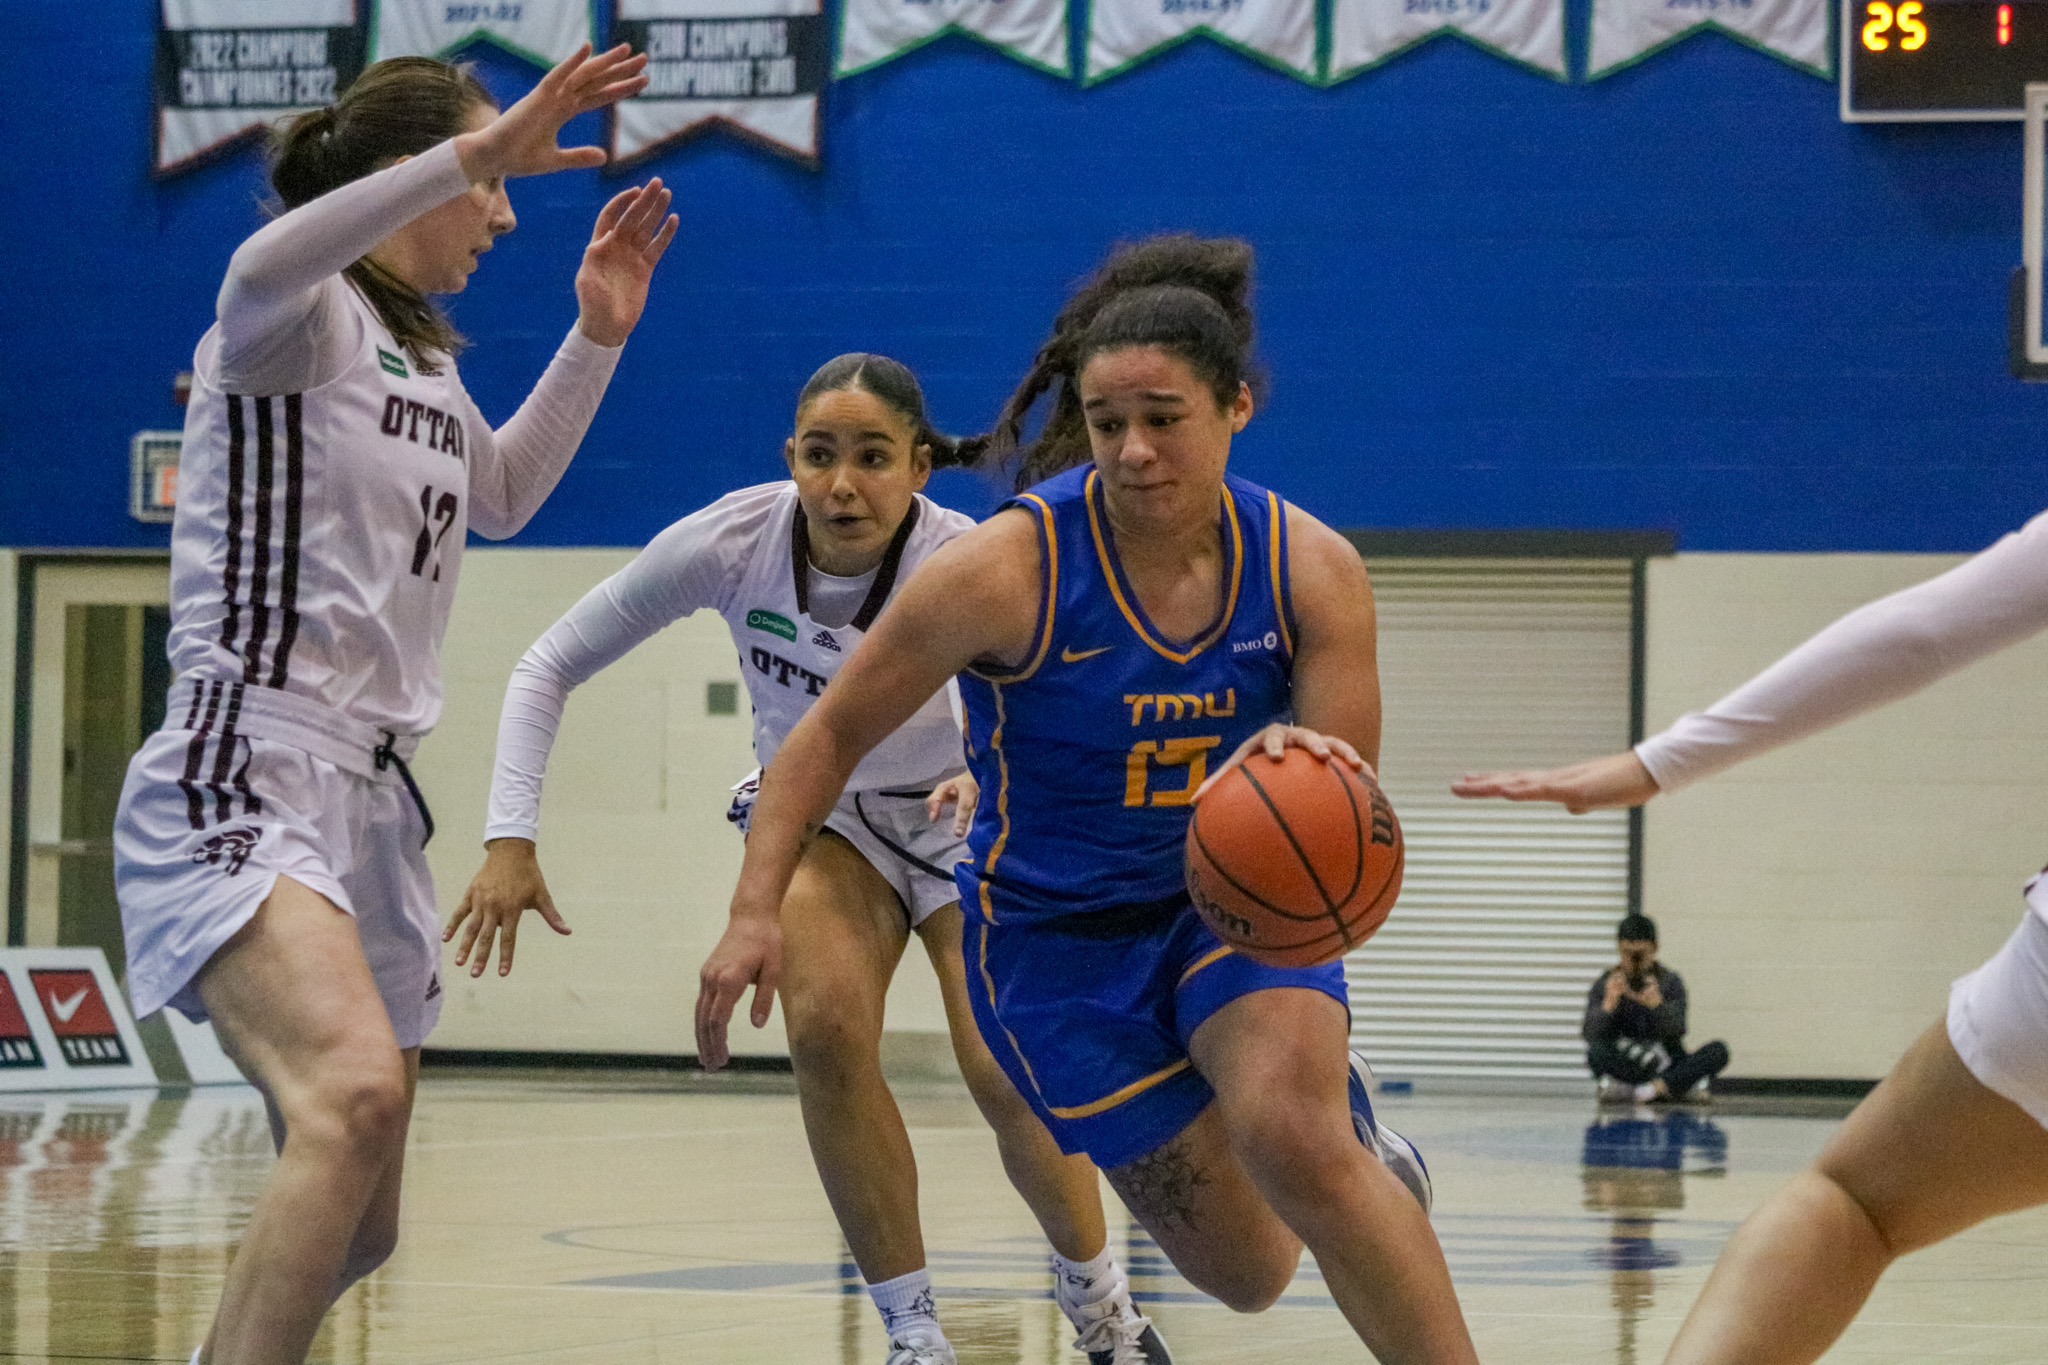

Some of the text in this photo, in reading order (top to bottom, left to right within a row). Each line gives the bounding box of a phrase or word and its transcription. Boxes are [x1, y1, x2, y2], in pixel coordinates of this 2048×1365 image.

[1862, 1, 1928, 51] 25
[1997, 4, 2012, 45] 1
[811, 637, 842, 653] adidas
[1233, 639, 1262, 653] BMO
[1123, 688, 1236, 727] TMU
[64, 1038, 122, 1060] TEAM
